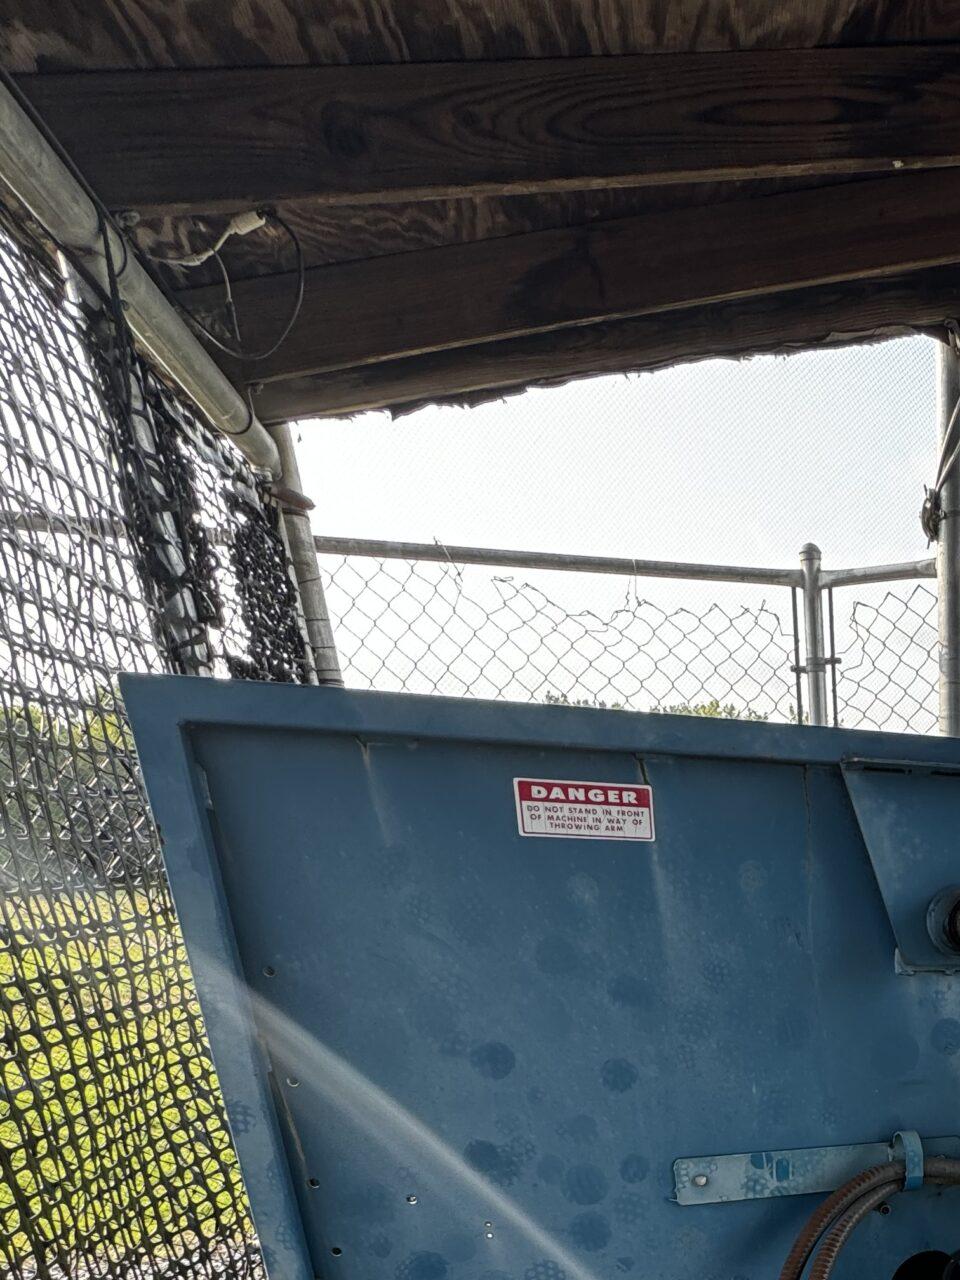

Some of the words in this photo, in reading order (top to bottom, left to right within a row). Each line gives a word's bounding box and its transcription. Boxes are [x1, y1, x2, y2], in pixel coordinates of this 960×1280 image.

[531, 785, 637, 803] DANGER
[568, 807, 598, 815] STAND
[602, 808, 612, 816] IN
[616, 809, 645, 817] FRONT
[547, 814, 588, 823] MACHINE
[592, 816, 602, 824] IN
[606, 817, 627, 825] WAY
[632, 818, 643, 826] OF
[549, 822, 601, 831] THROWING
[604, 824, 624, 832] ARM
